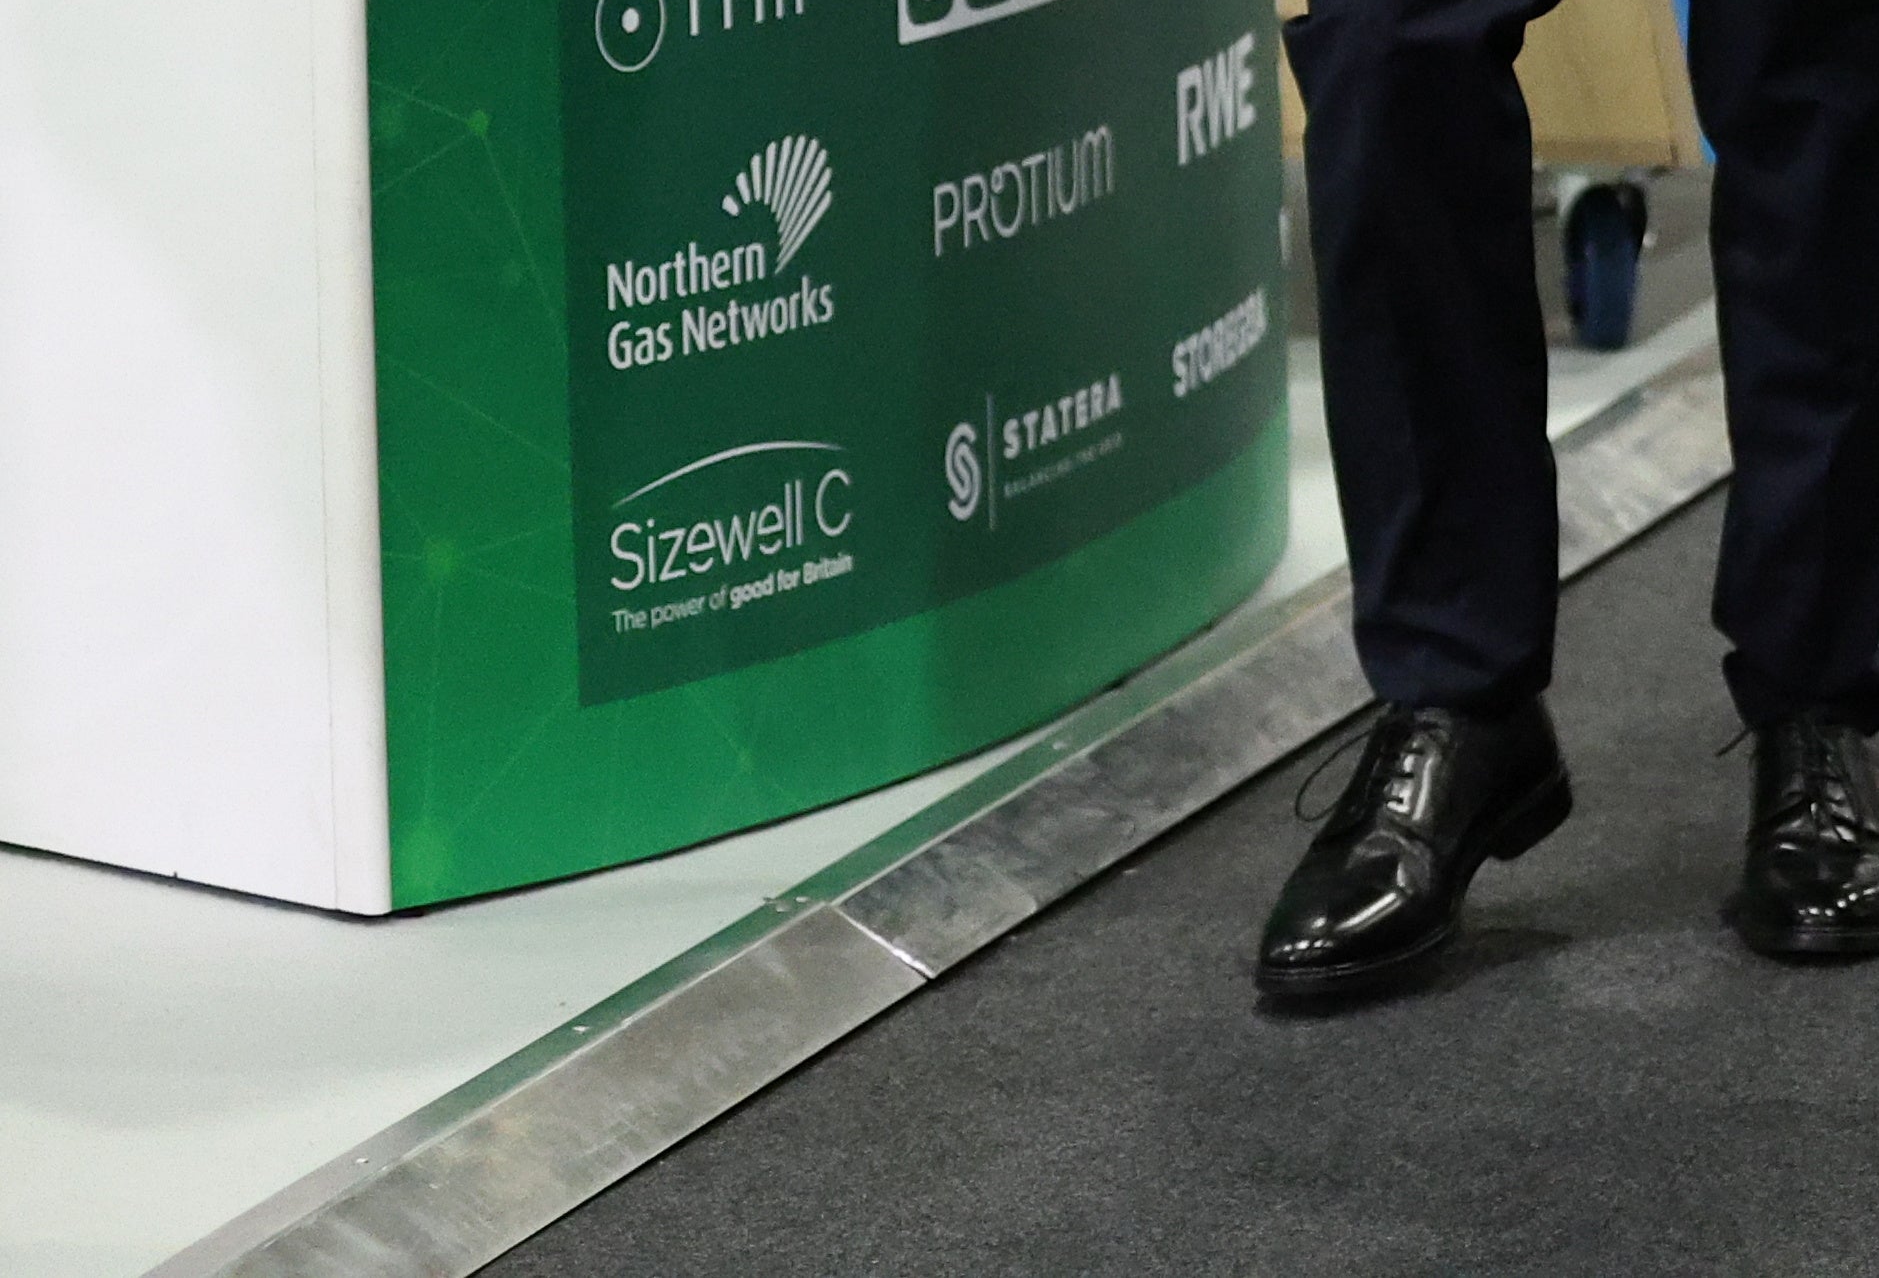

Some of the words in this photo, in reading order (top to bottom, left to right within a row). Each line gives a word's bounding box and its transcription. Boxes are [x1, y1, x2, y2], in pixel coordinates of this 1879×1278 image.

[1175, 31, 1257, 167] RWE
[932, 124, 1115, 258] PROTIUM
[606, 241, 767, 312] Northern
[606, 316, 673, 371] Gas
[681, 274, 835, 357] Networks
[1002, 371, 1123, 461] STATERA
[610, 478, 804, 591] Sizewell
[814, 468, 852, 537] C
[611, 608, 648, 634] The
[650, 595, 706, 630] power
[708, 584, 728, 610] of
[729, 572, 775, 610] good
[776, 567, 801, 593] for
[802, 551, 855, 586] Britain
